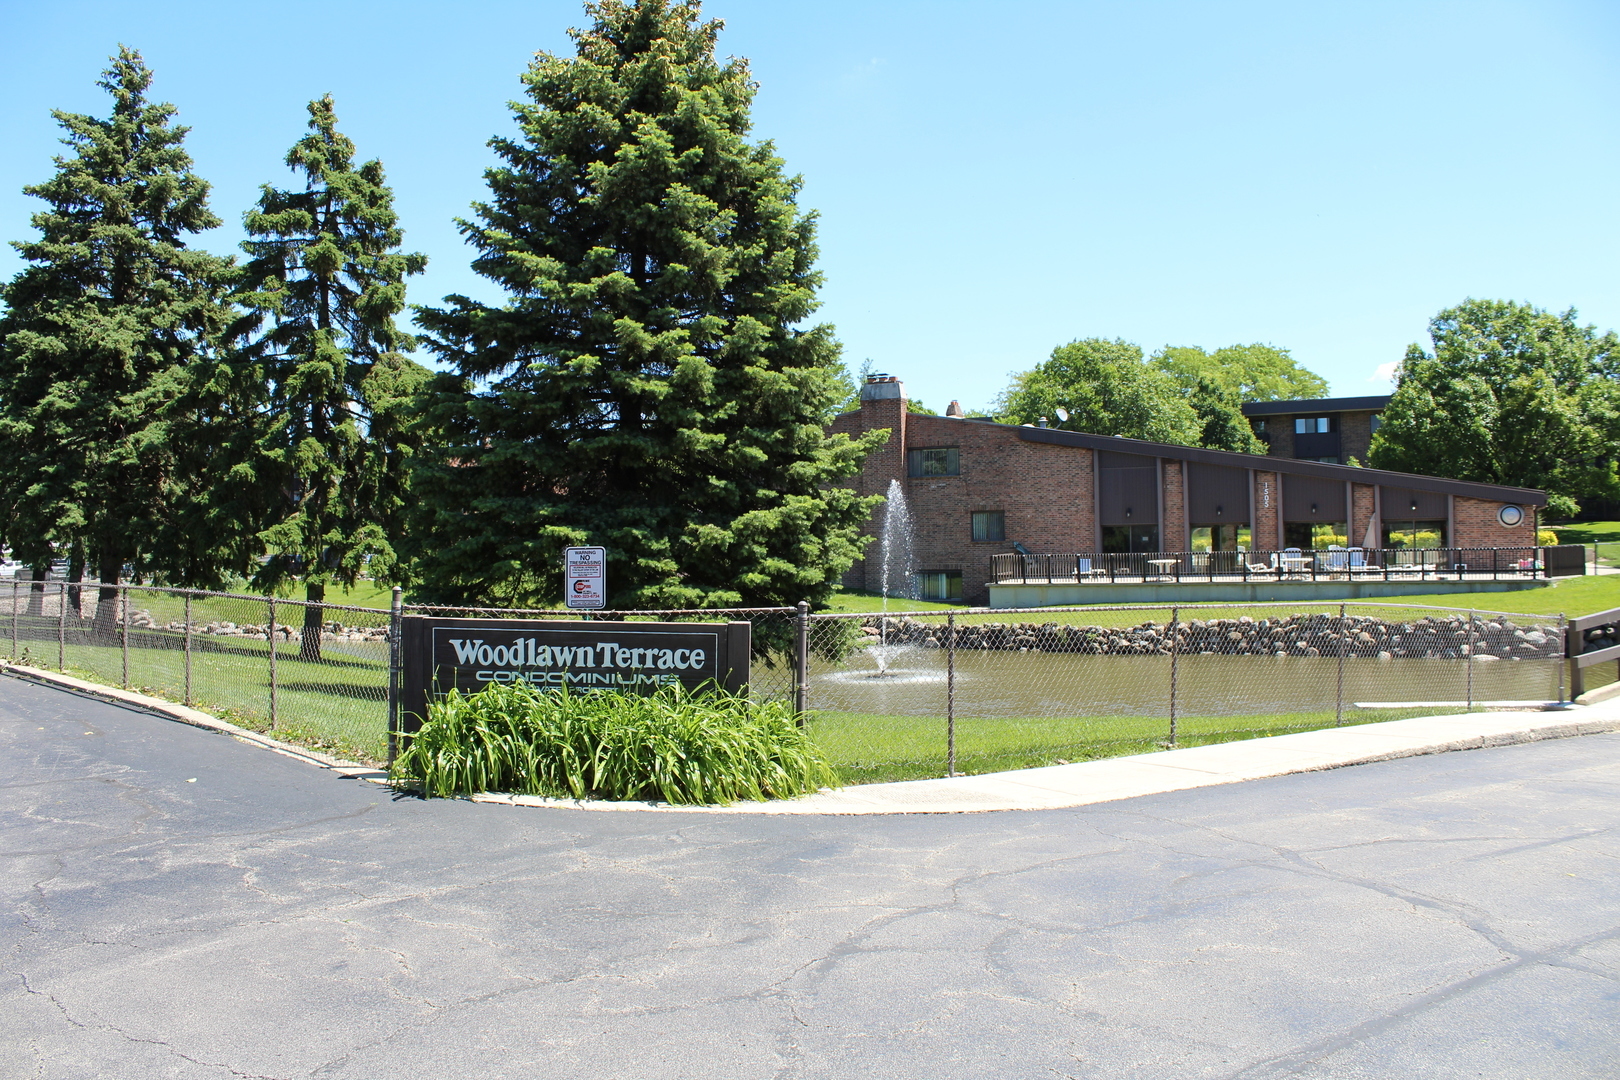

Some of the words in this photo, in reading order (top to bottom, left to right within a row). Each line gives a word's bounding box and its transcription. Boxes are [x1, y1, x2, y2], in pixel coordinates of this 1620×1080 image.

[449, 637, 596, 667] Woodlawn
[596, 642, 705, 670] Terrace
[475, 670, 680, 686] CONDOMINIUMS
